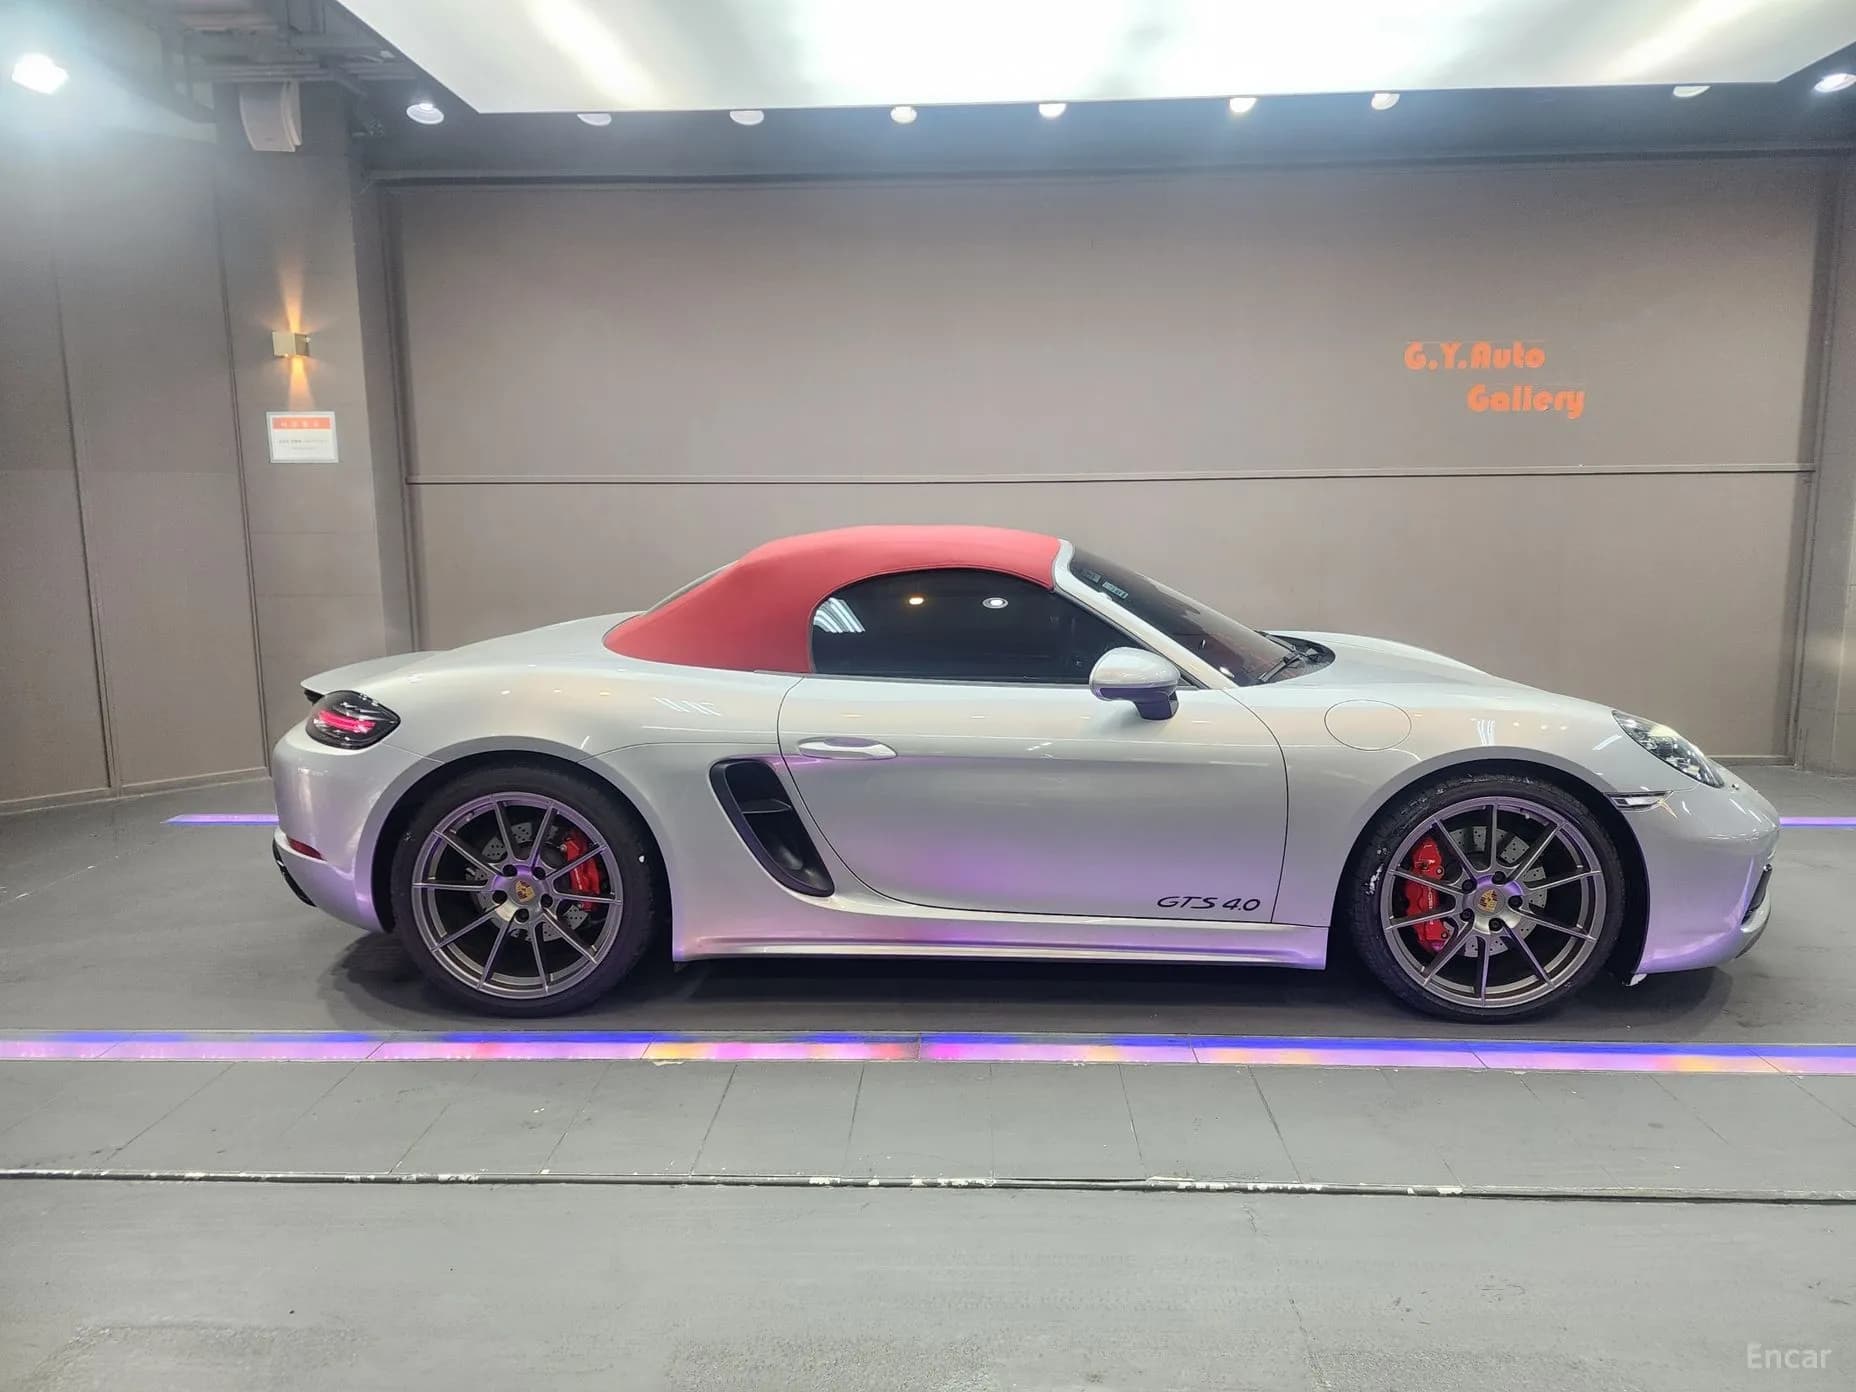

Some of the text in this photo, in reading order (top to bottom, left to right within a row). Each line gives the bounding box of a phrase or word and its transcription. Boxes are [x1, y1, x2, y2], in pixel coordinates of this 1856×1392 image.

[1404, 340, 1546, 370] G.Y.Auto
[1466, 383, 1585, 420] Gallery
[1157, 896, 1261, 912] GTS 4.0
